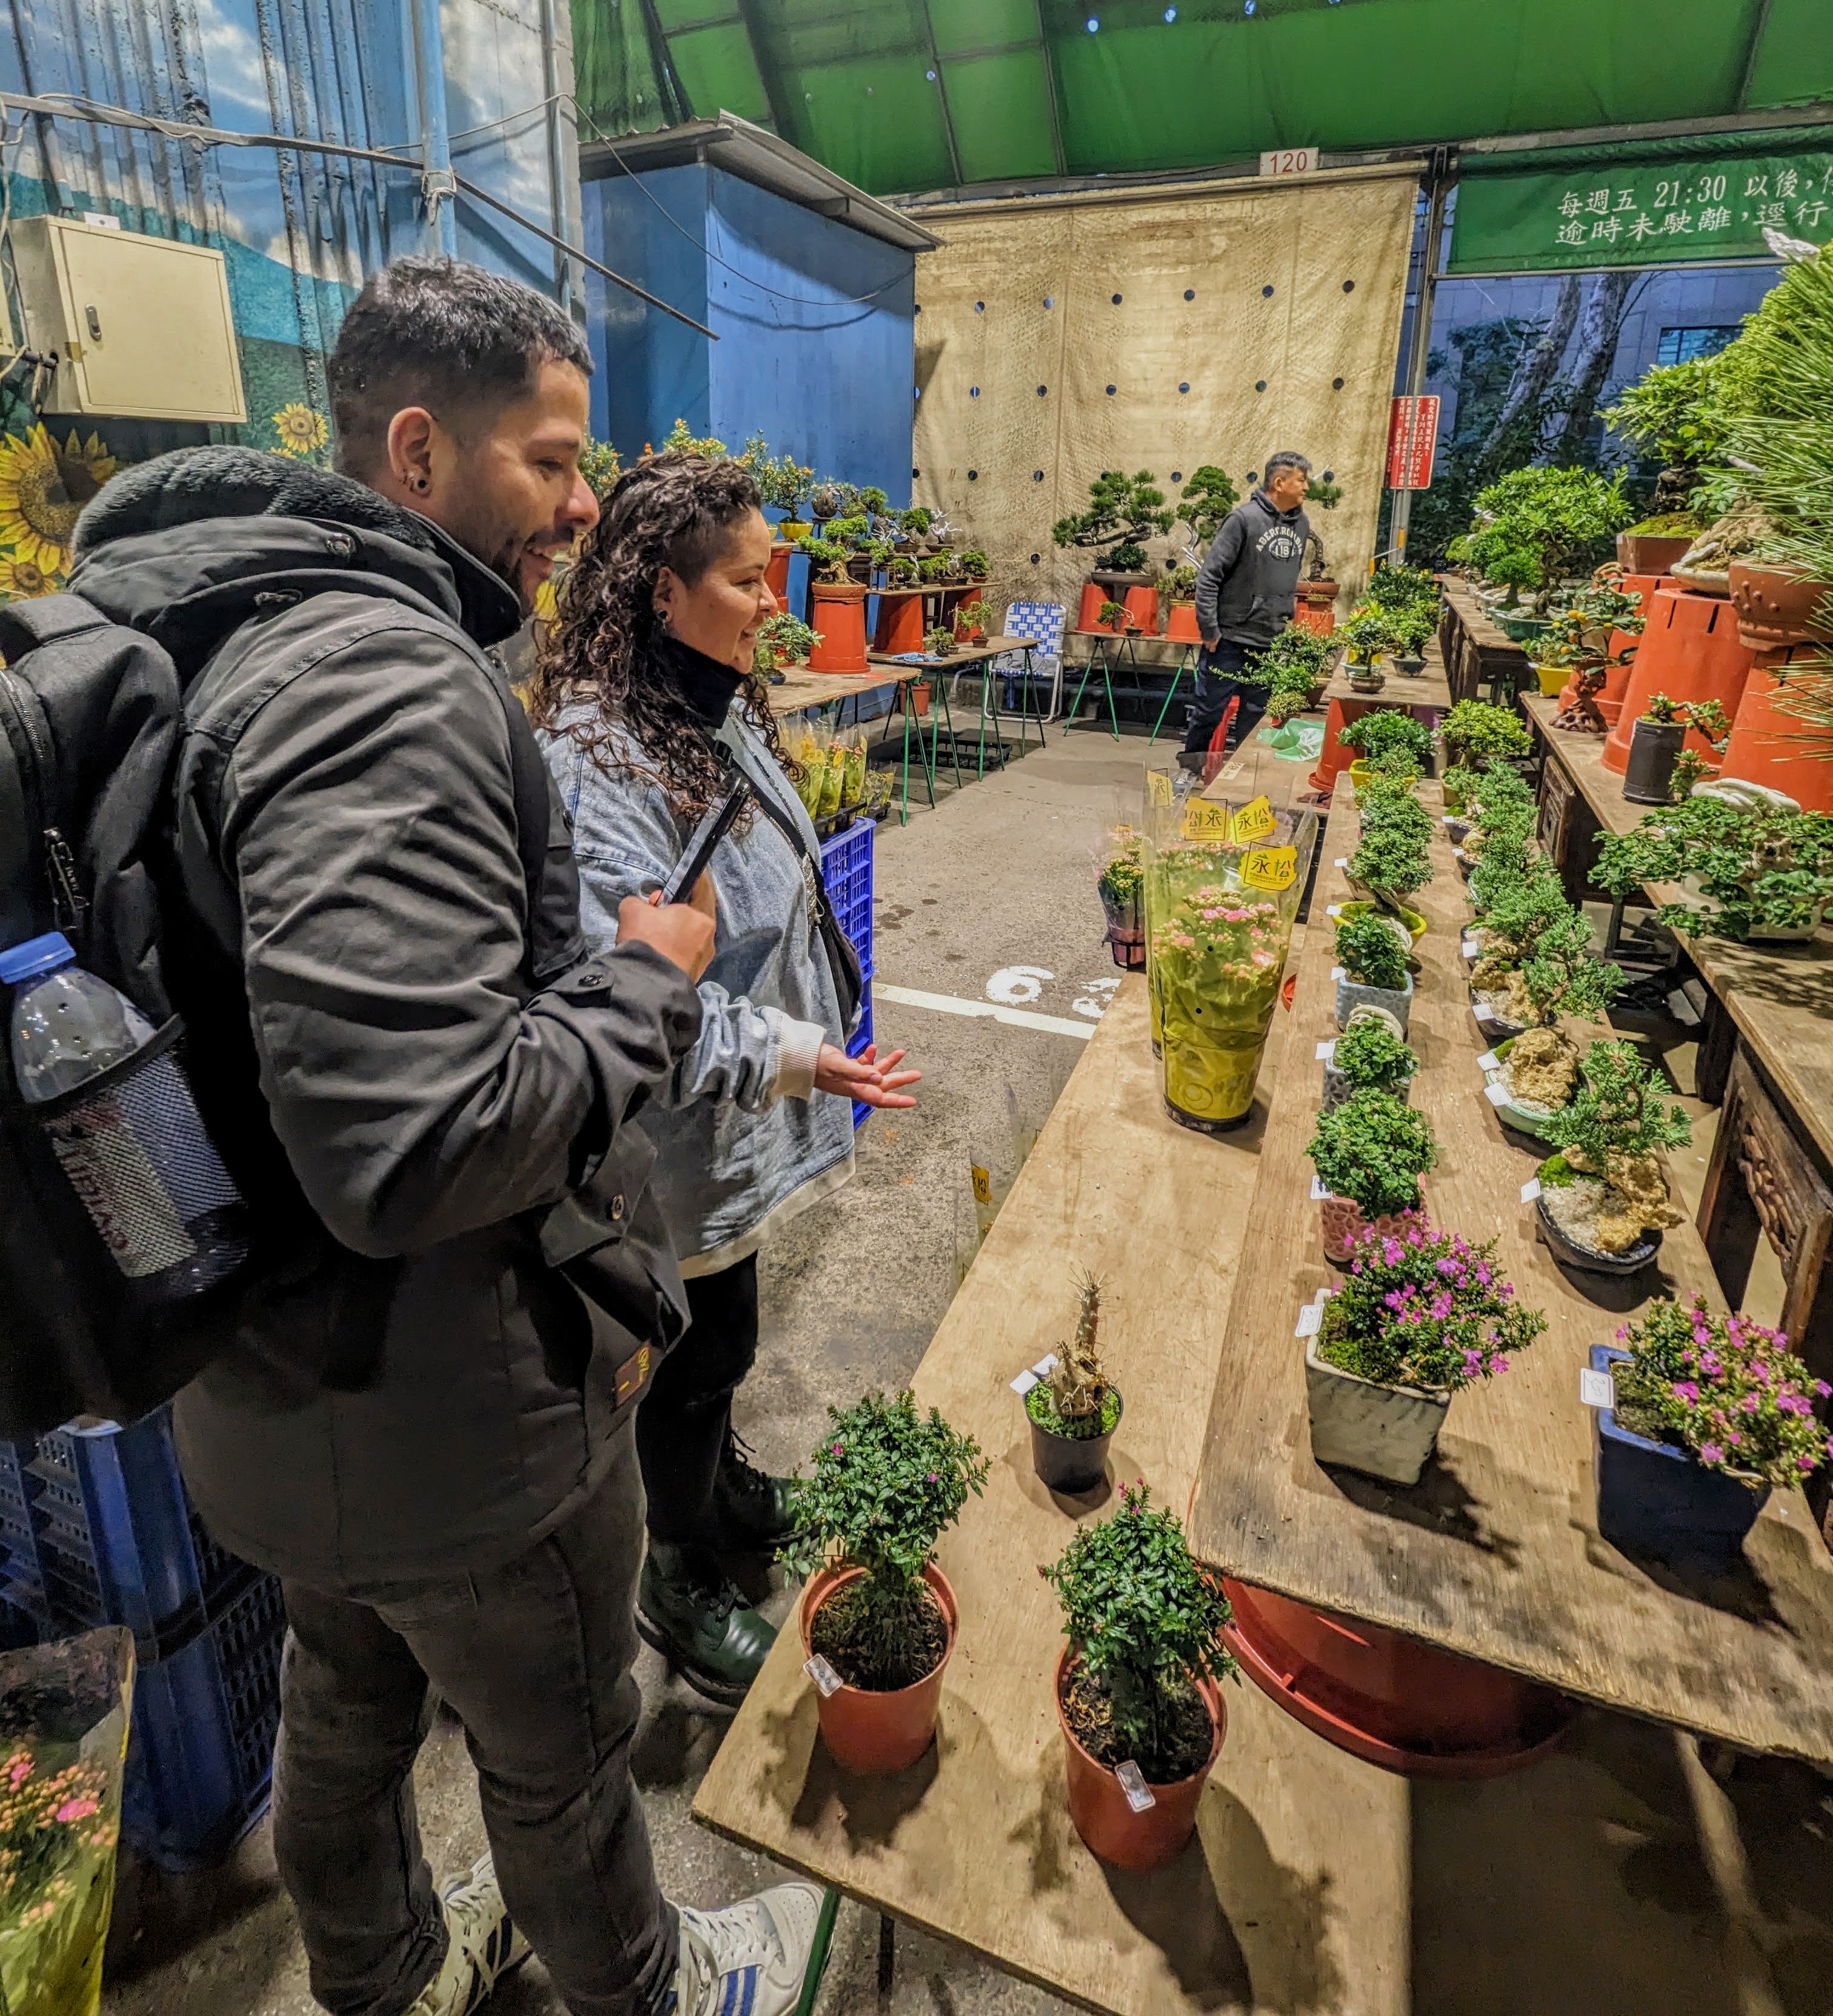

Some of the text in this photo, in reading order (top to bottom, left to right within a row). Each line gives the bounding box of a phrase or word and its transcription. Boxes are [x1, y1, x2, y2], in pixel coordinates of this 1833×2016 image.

[1270, 151, 1307, 173] 120
[1557, 188, 1637, 219] 每週五
[1654, 175, 1726, 208] 21:30
[1250, 853, 1290, 877] 永松
